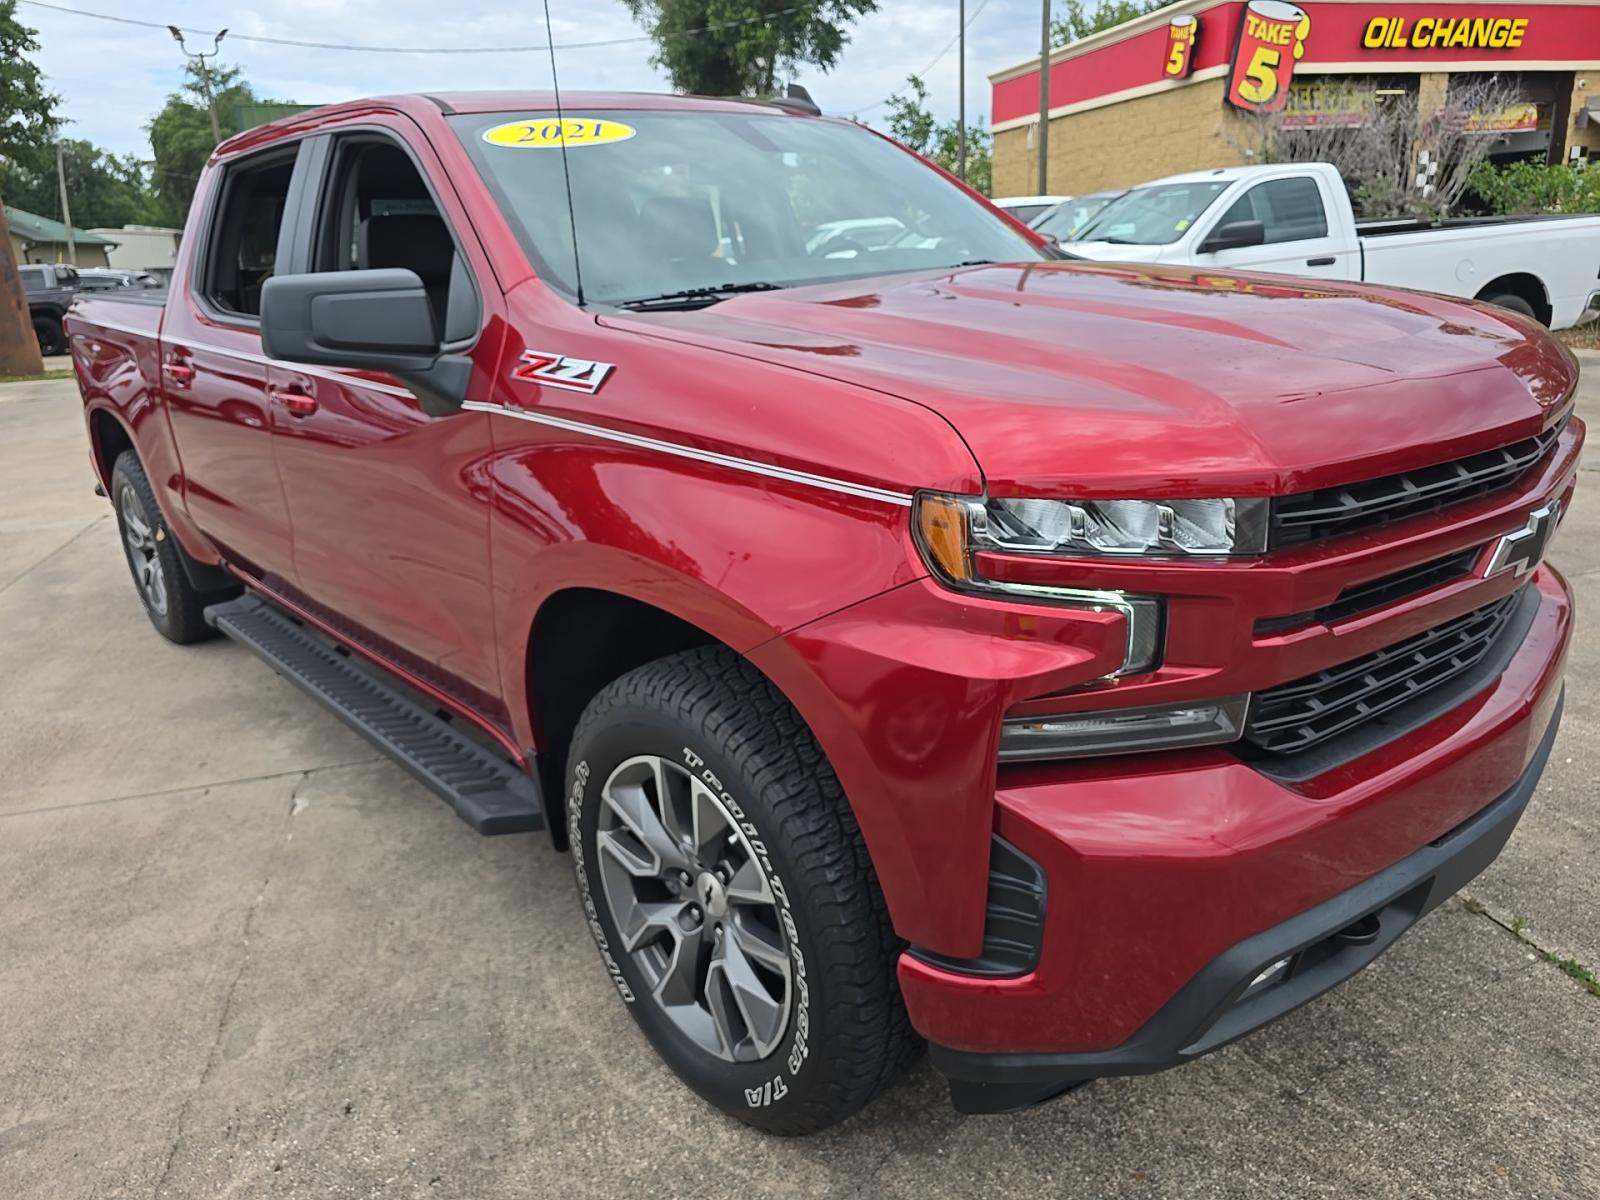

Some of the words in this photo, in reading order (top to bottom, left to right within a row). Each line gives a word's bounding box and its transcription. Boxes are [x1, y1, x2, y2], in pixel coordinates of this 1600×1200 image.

[1170, 26, 1191, 40] TAKE
[1247, 14, 1292, 46] TAKE
[1363, 16, 1408, 48] OIL
[1411, 17, 1529, 48] CHANGE
[1166, 42, 1185, 75] 5
[1237, 46, 1281, 103] 5
[518, 123, 602, 142] 2021
[511, 349, 617, 394] Z71
[744, 1074, 788, 1108] T/A
